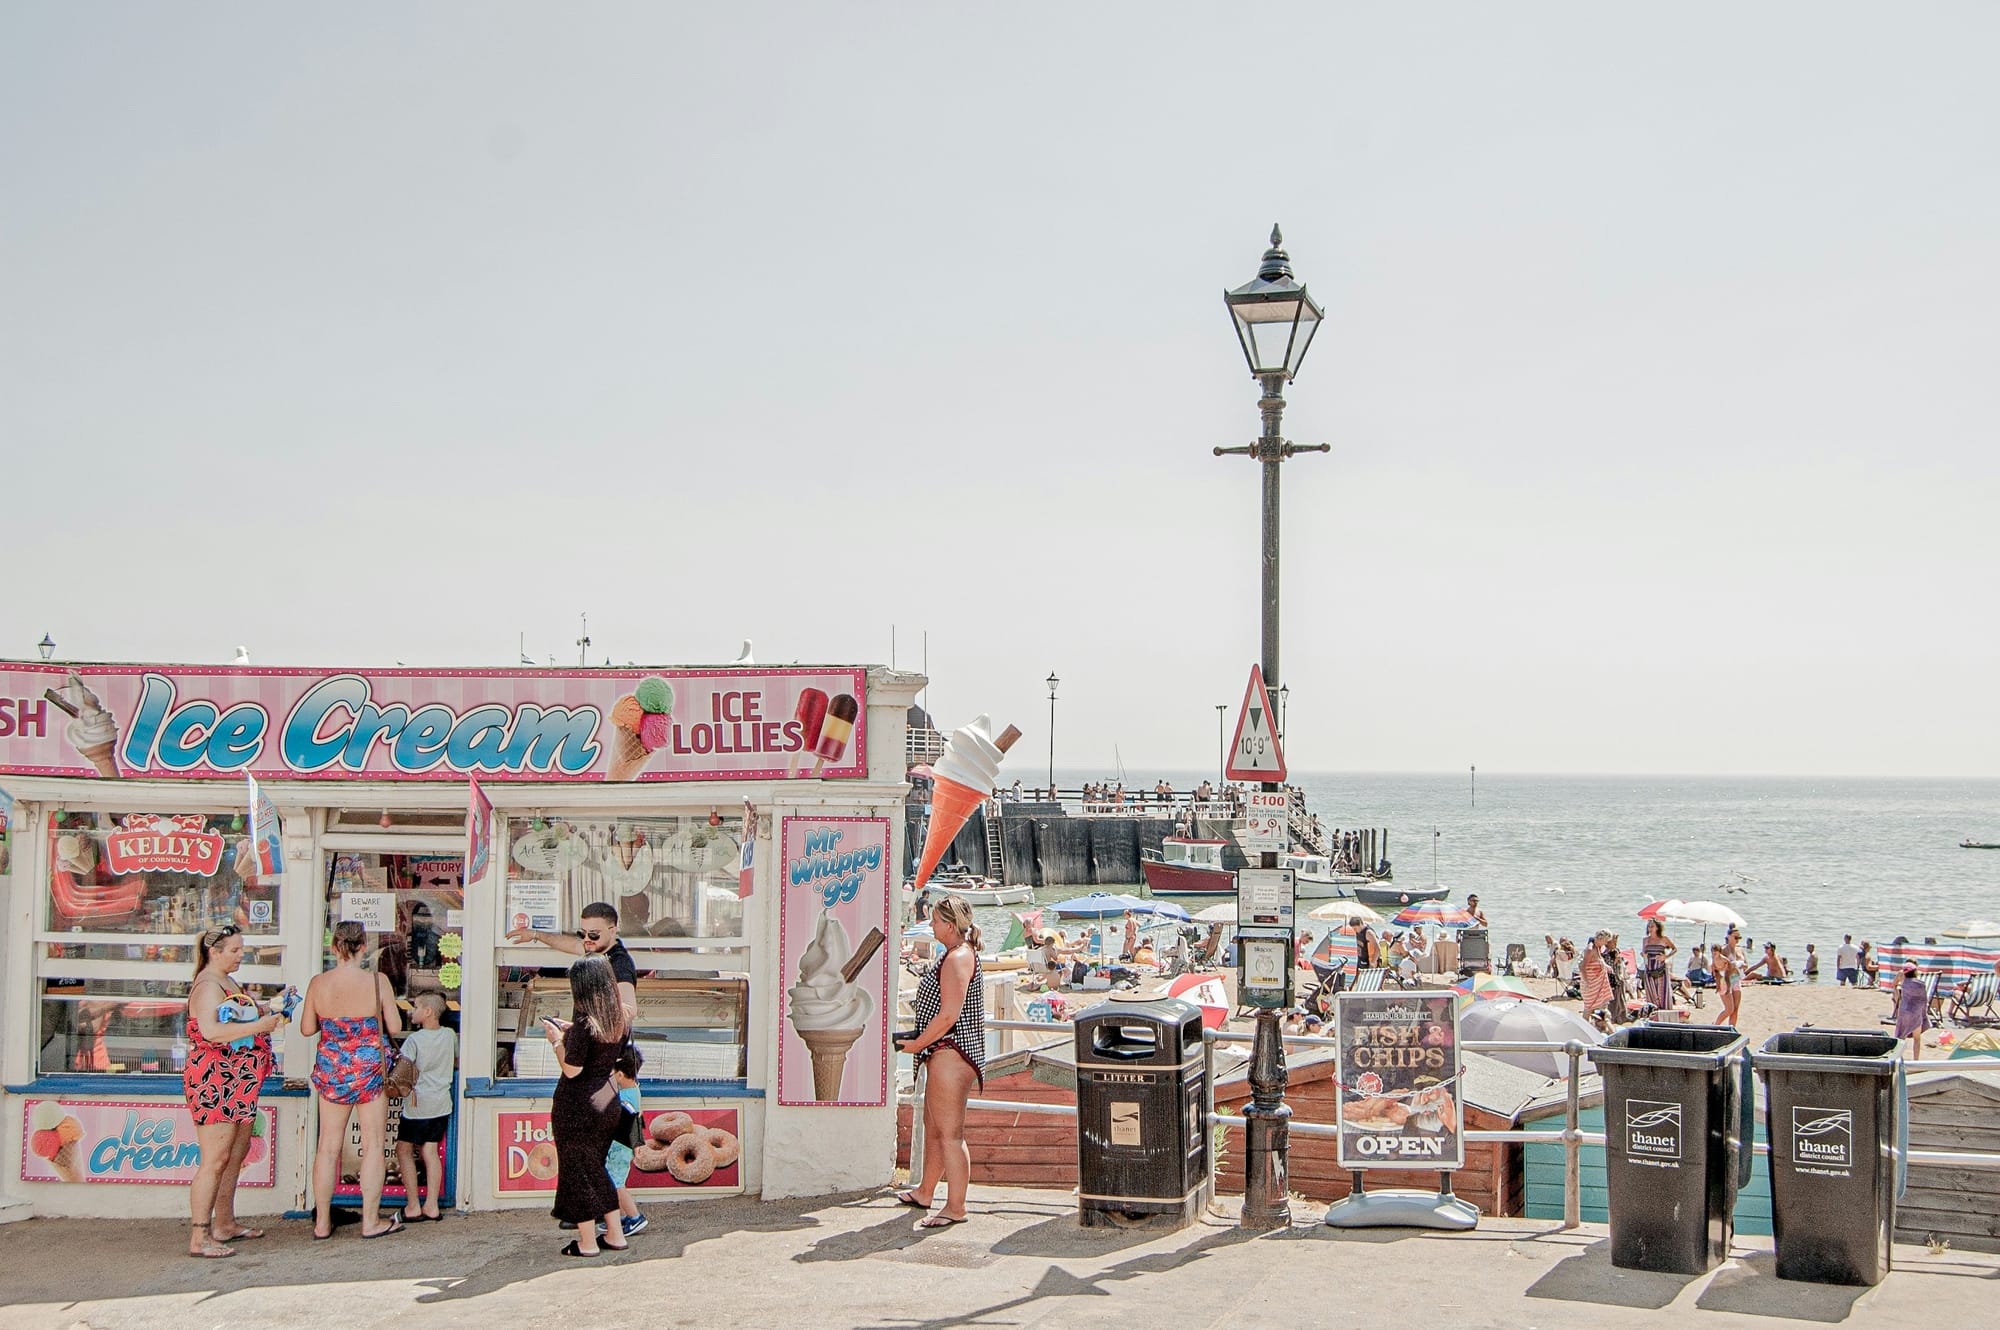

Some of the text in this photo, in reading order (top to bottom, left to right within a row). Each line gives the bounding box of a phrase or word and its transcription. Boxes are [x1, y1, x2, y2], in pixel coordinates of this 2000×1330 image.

[711, 691, 763, 723] ICE
[122, 673, 601, 774] Ice Cream
[672, 721, 804, 755] LOLLIES
[1252, 795, 1285, 806] £100
[117, 836, 213, 860] KELLY'S
[805, 827, 843, 857] Mr
[150, 856, 191, 865] CORNWALL
[416, 862, 462, 872] FACTORY
[790, 844, 882, 887] Whippy
[351, 897, 381, 905] BEWARE
[1353, 1025, 1445, 1046] FISH &
[1353, 1047, 1445, 1068] CHIPS
[1103, 1073, 1145, 1082] LITTER
[120, 1109, 176, 1146] Ice
[1356, 1135, 1446, 1155] OPEN
[1631, 1131, 1676, 1146] thanet
[1632, 1143, 1652, 1151] district
[1798, 1139, 1846, 1154] thanet
[88, 1136, 202, 1175] Cream
[1799, 1151, 1820, 1160] district
[1795, 1167, 1850, 1176] www.thanet.gov.uk
